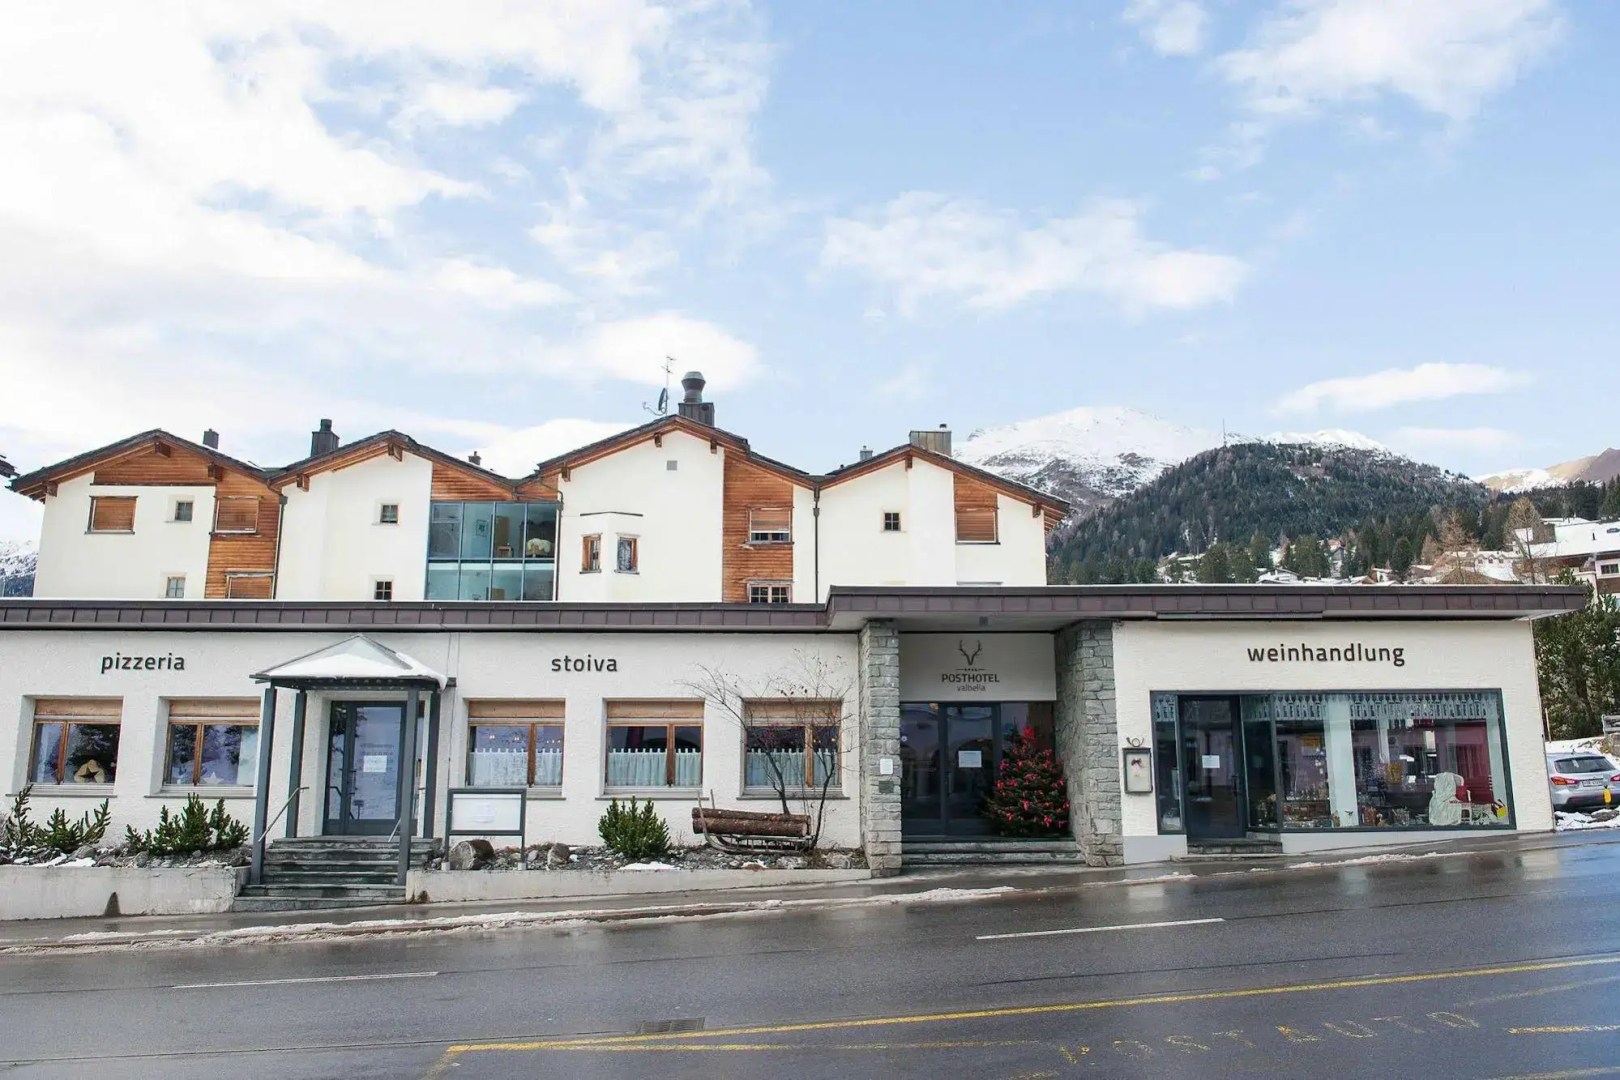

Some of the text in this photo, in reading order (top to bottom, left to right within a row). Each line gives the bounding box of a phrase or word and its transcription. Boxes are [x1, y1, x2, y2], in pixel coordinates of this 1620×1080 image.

[101, 652, 185, 674] pizzeria
[551, 654, 618, 672] stoiva
[1247, 642, 1405, 666] weinhandlung
[941, 673, 1000, 683] POSTHOTEL
[956, 683, 986, 692] valbella
